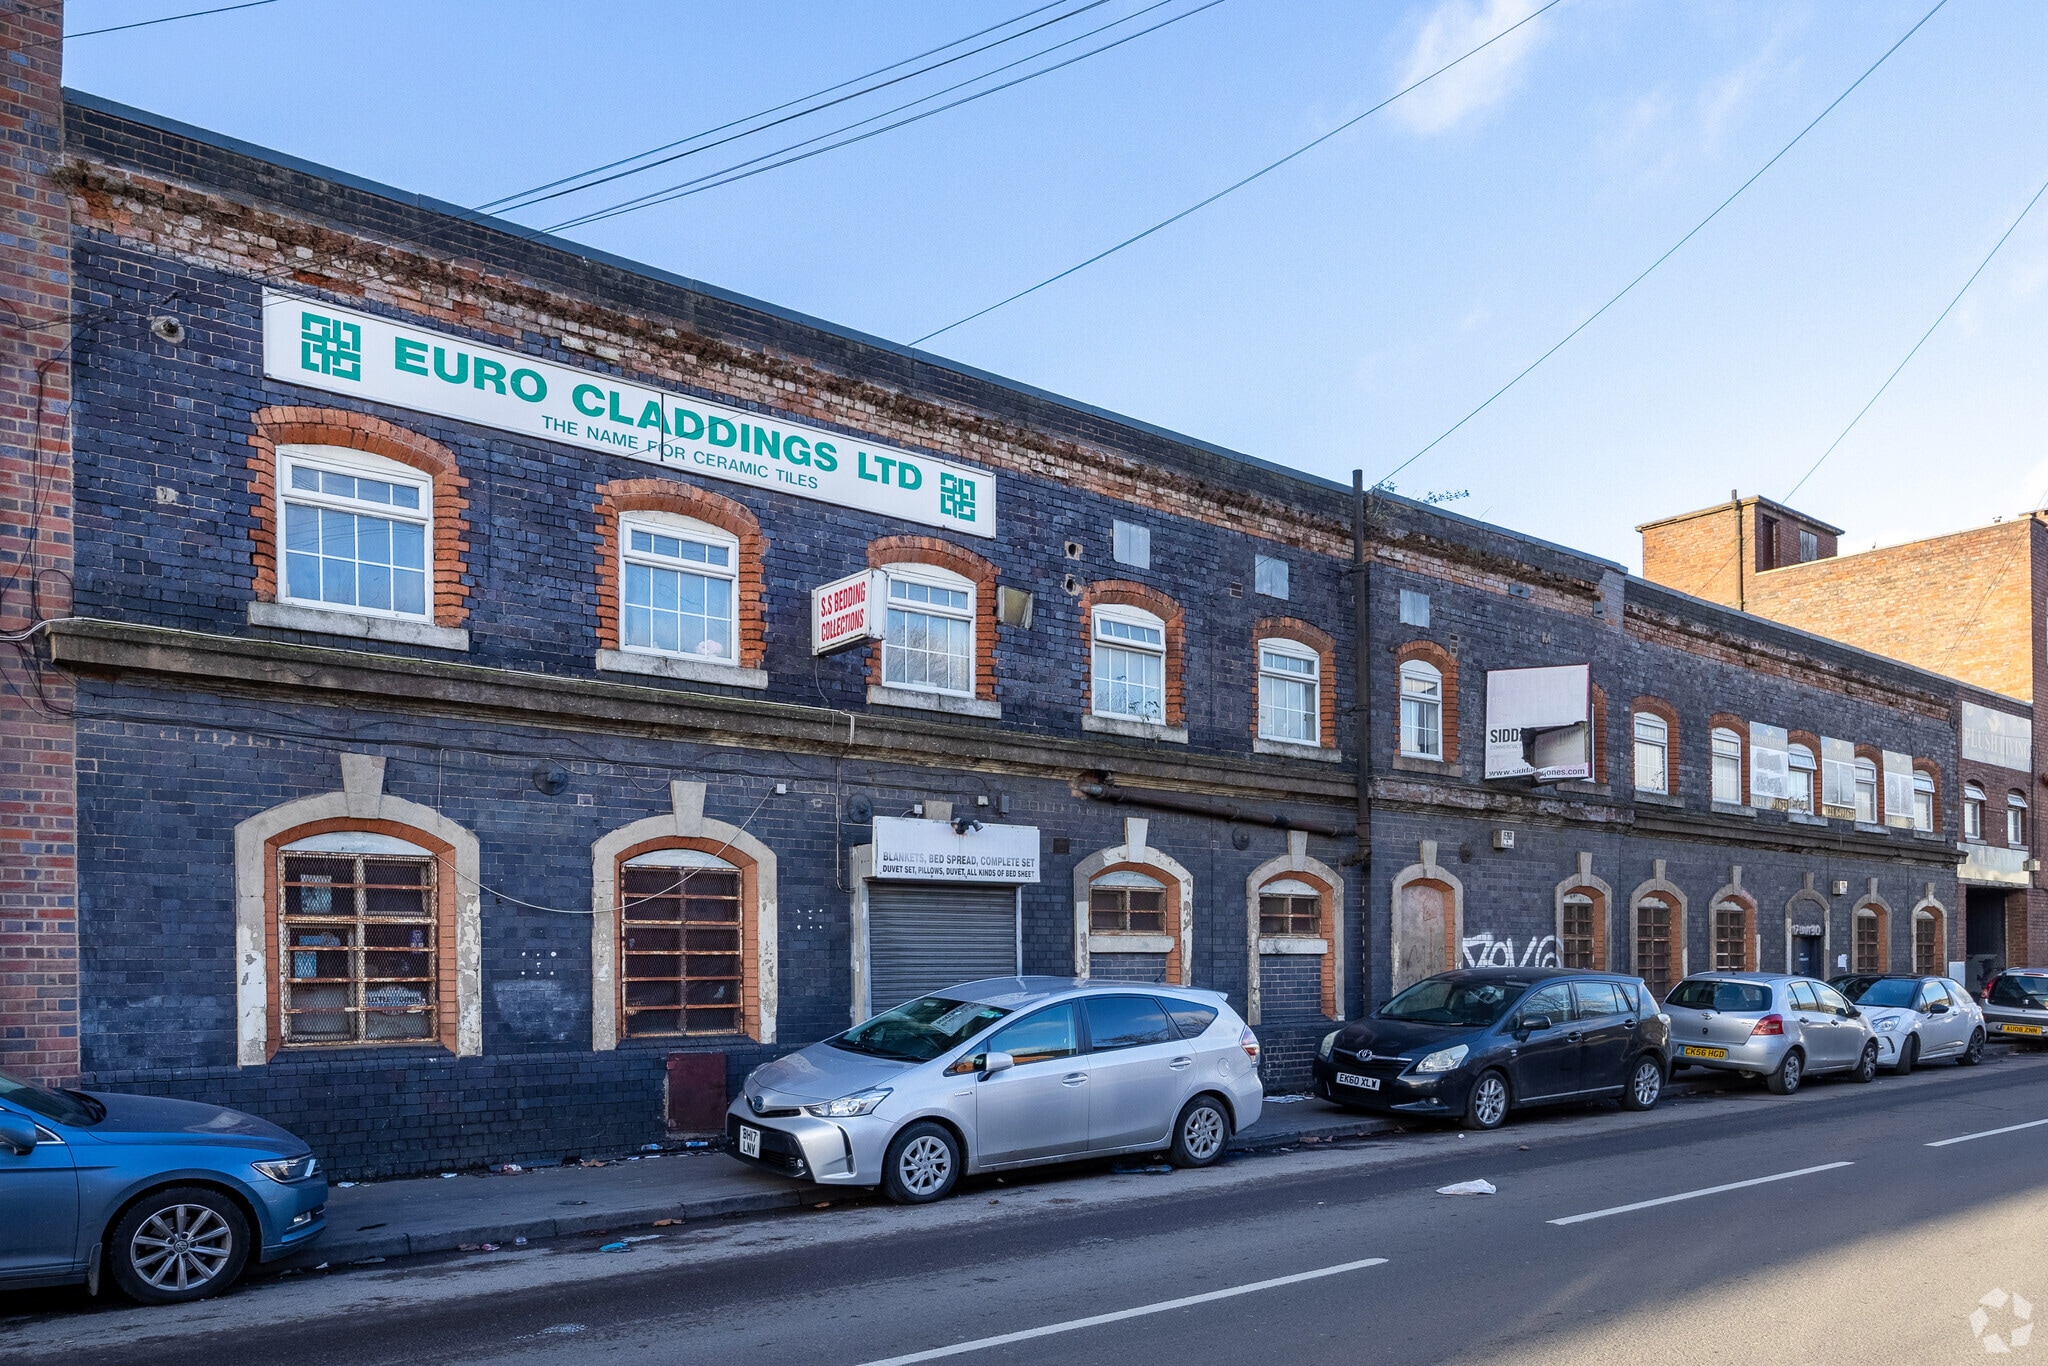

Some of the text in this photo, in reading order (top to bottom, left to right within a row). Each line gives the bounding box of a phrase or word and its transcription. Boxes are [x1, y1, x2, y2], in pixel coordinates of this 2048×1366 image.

[394, 336, 923, 491] EURO CLADDINGS LTD
[541, 414, 818, 490] THE NAME FOR CERAMIC TILES
[821, 580, 866, 618] S.S BEDDING
[821, 608, 865, 642] COLLECTIONS
[1490, 728, 1521, 743] SIDD
[882, 864, 1035, 878] DUVET SET, PILLOWS, DUVET, ALL KINDS OF BED SHEET
[883, 851, 1035, 868] BLANKETS, BED SPREAD, COMPLETE SET
[1340, 1073, 1360, 1085] EK60
